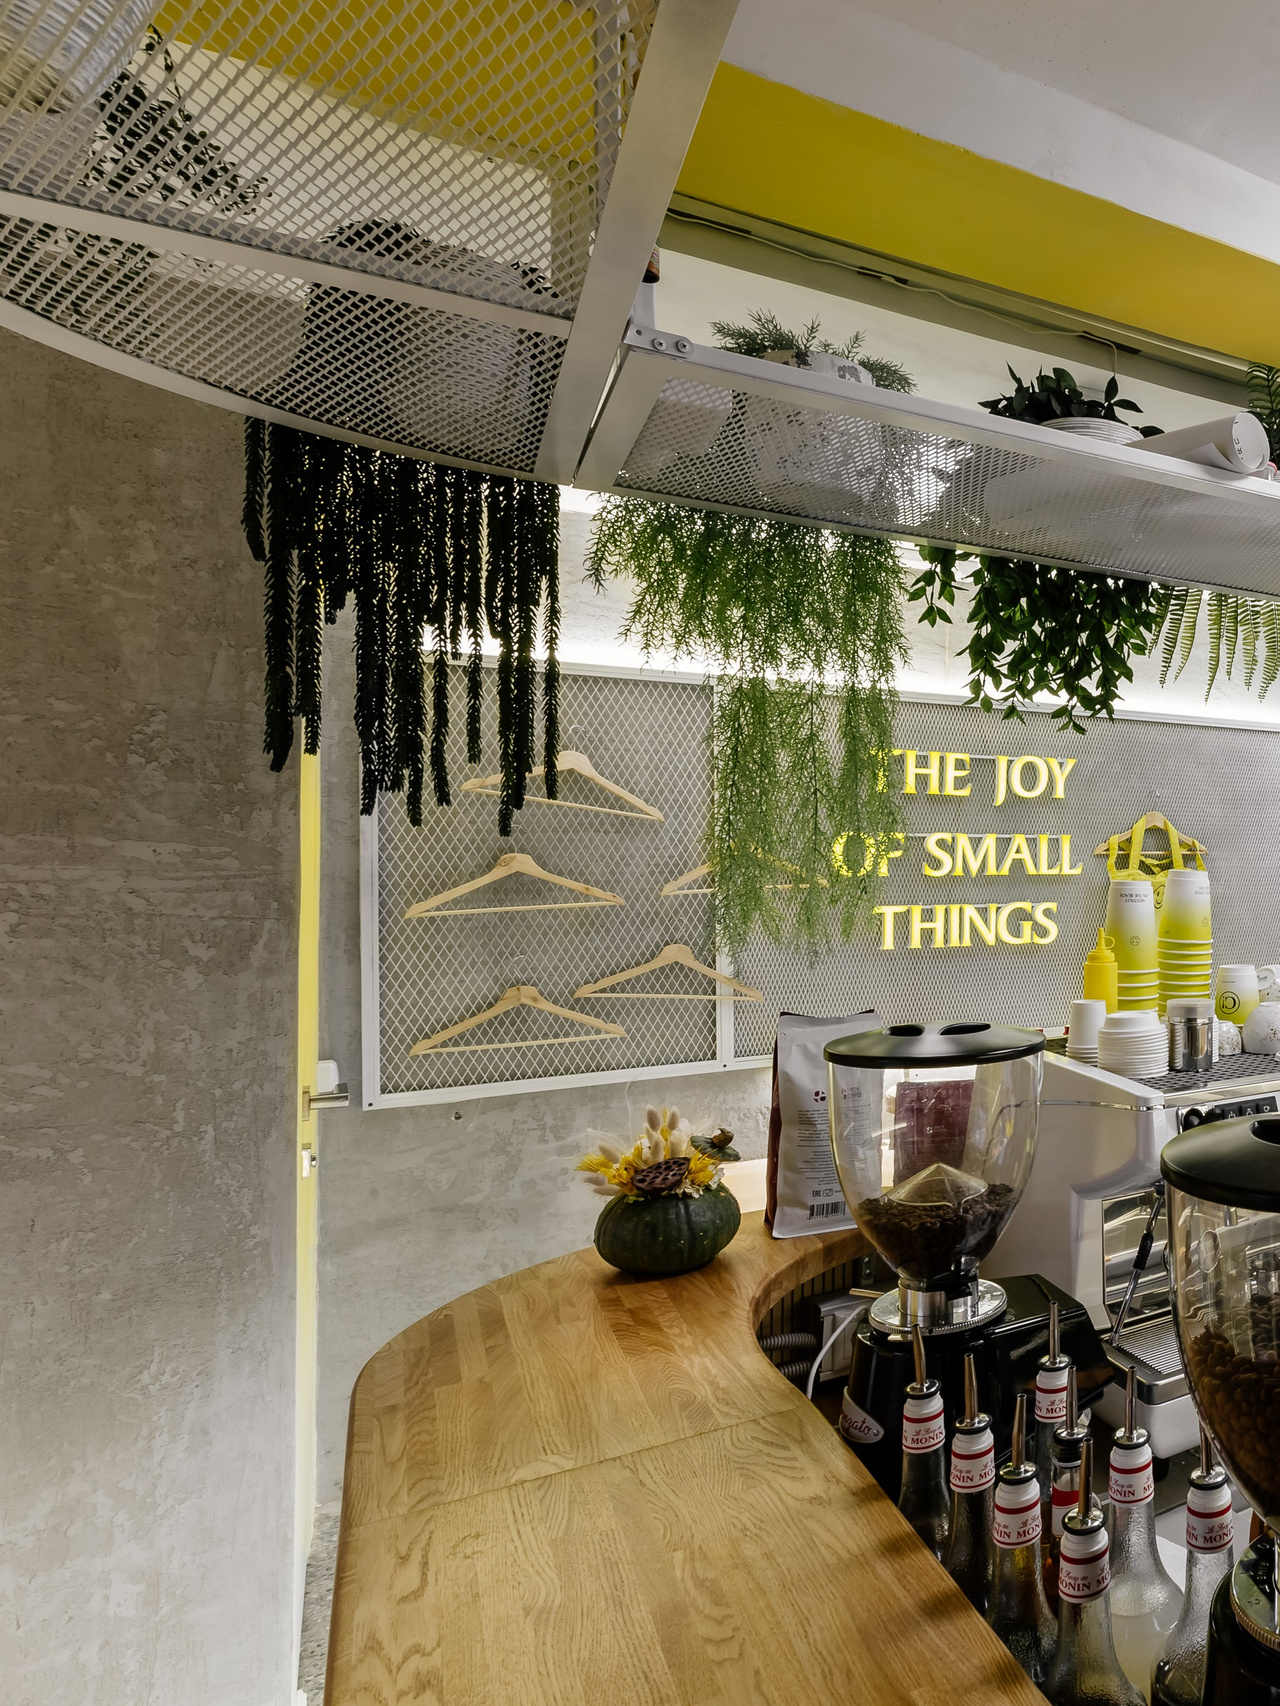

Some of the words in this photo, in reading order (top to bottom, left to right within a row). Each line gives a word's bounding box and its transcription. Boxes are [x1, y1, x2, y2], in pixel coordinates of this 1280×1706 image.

[866, 749, 972, 797] THE
[993, 755, 1077, 807] JOY
[832, 831, 905, 878] OF
[923, 832, 1084, 878] SMALL
[872, 901, 1059, 950] THINGS
[910, 1431, 944, 1445] MONIN
[1016, 1523, 1040, 1539] MON
